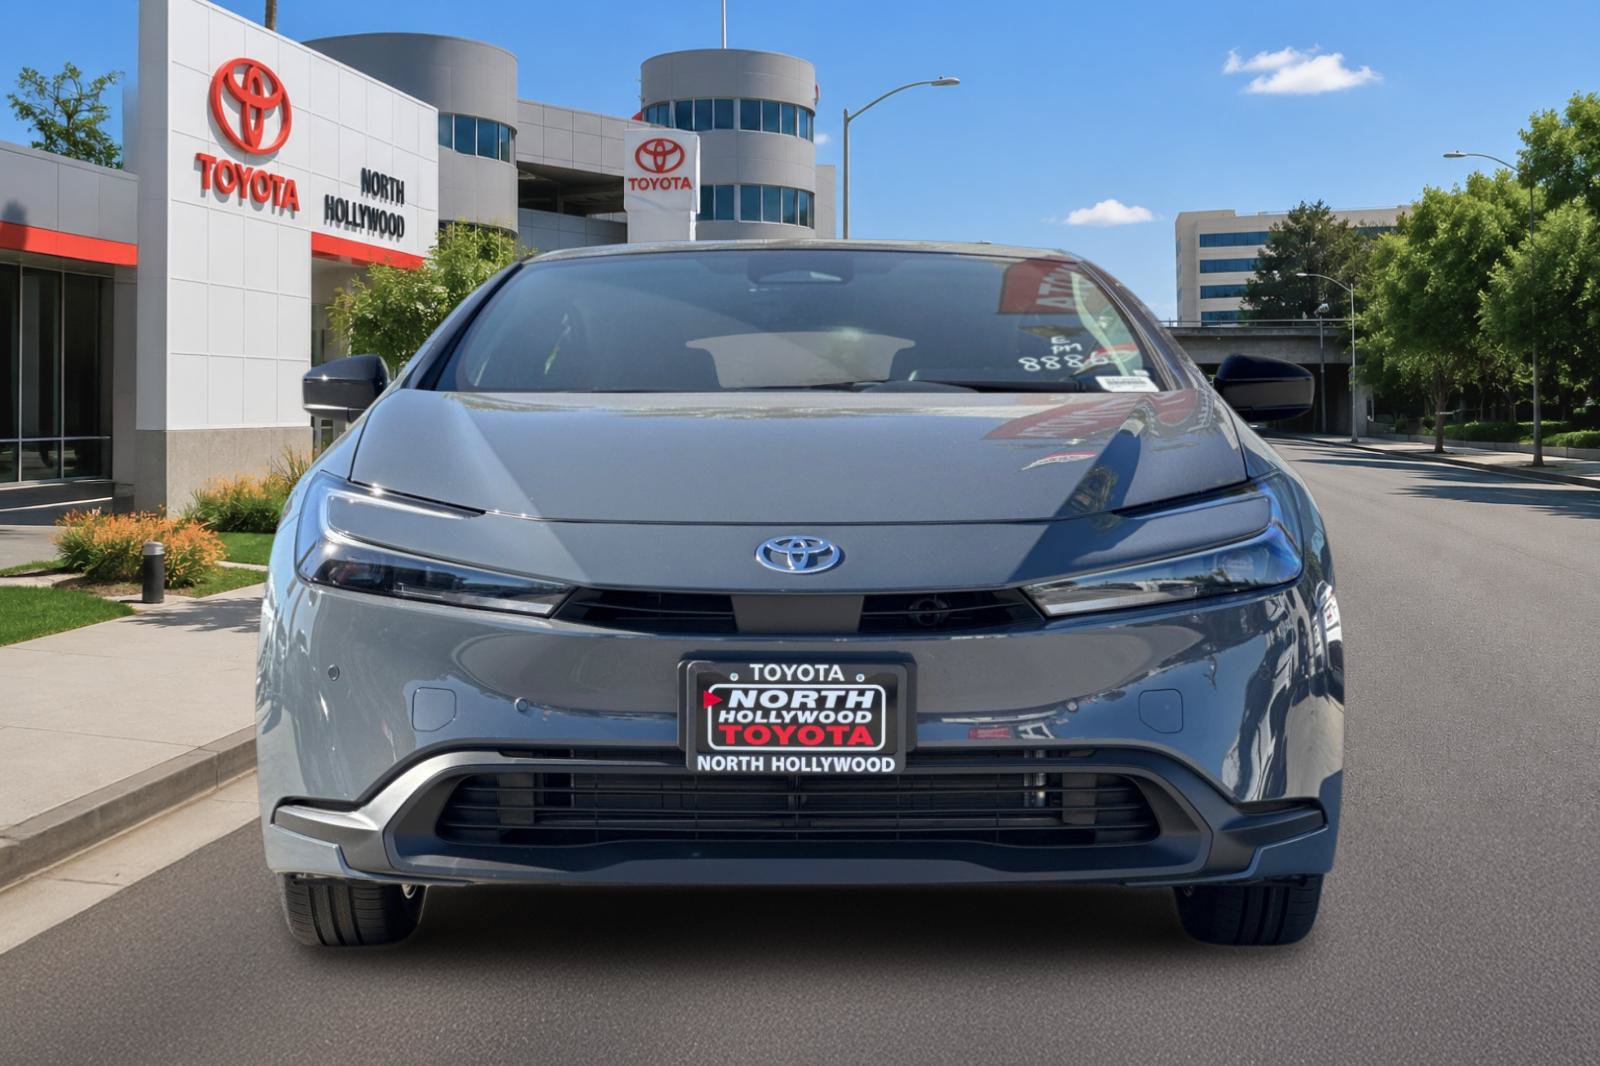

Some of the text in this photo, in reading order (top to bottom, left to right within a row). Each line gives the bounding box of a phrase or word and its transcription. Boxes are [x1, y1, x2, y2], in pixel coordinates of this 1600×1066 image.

[195, 152, 300, 212] TOYOTA
[361, 168, 405, 204] NORTH
[628, 177, 693, 191] TOYOTA
[324, 194, 405, 238] HOLLYWOOD
[750, 664, 845, 682] TOYOTA
[728, 690, 875, 709] NORTH
[718, 710, 872, 724] HOLLYWOOD
[718, 725, 874, 746] TOYOTA
[697, 756, 896, 773] NORTH HOLLYWOOD
